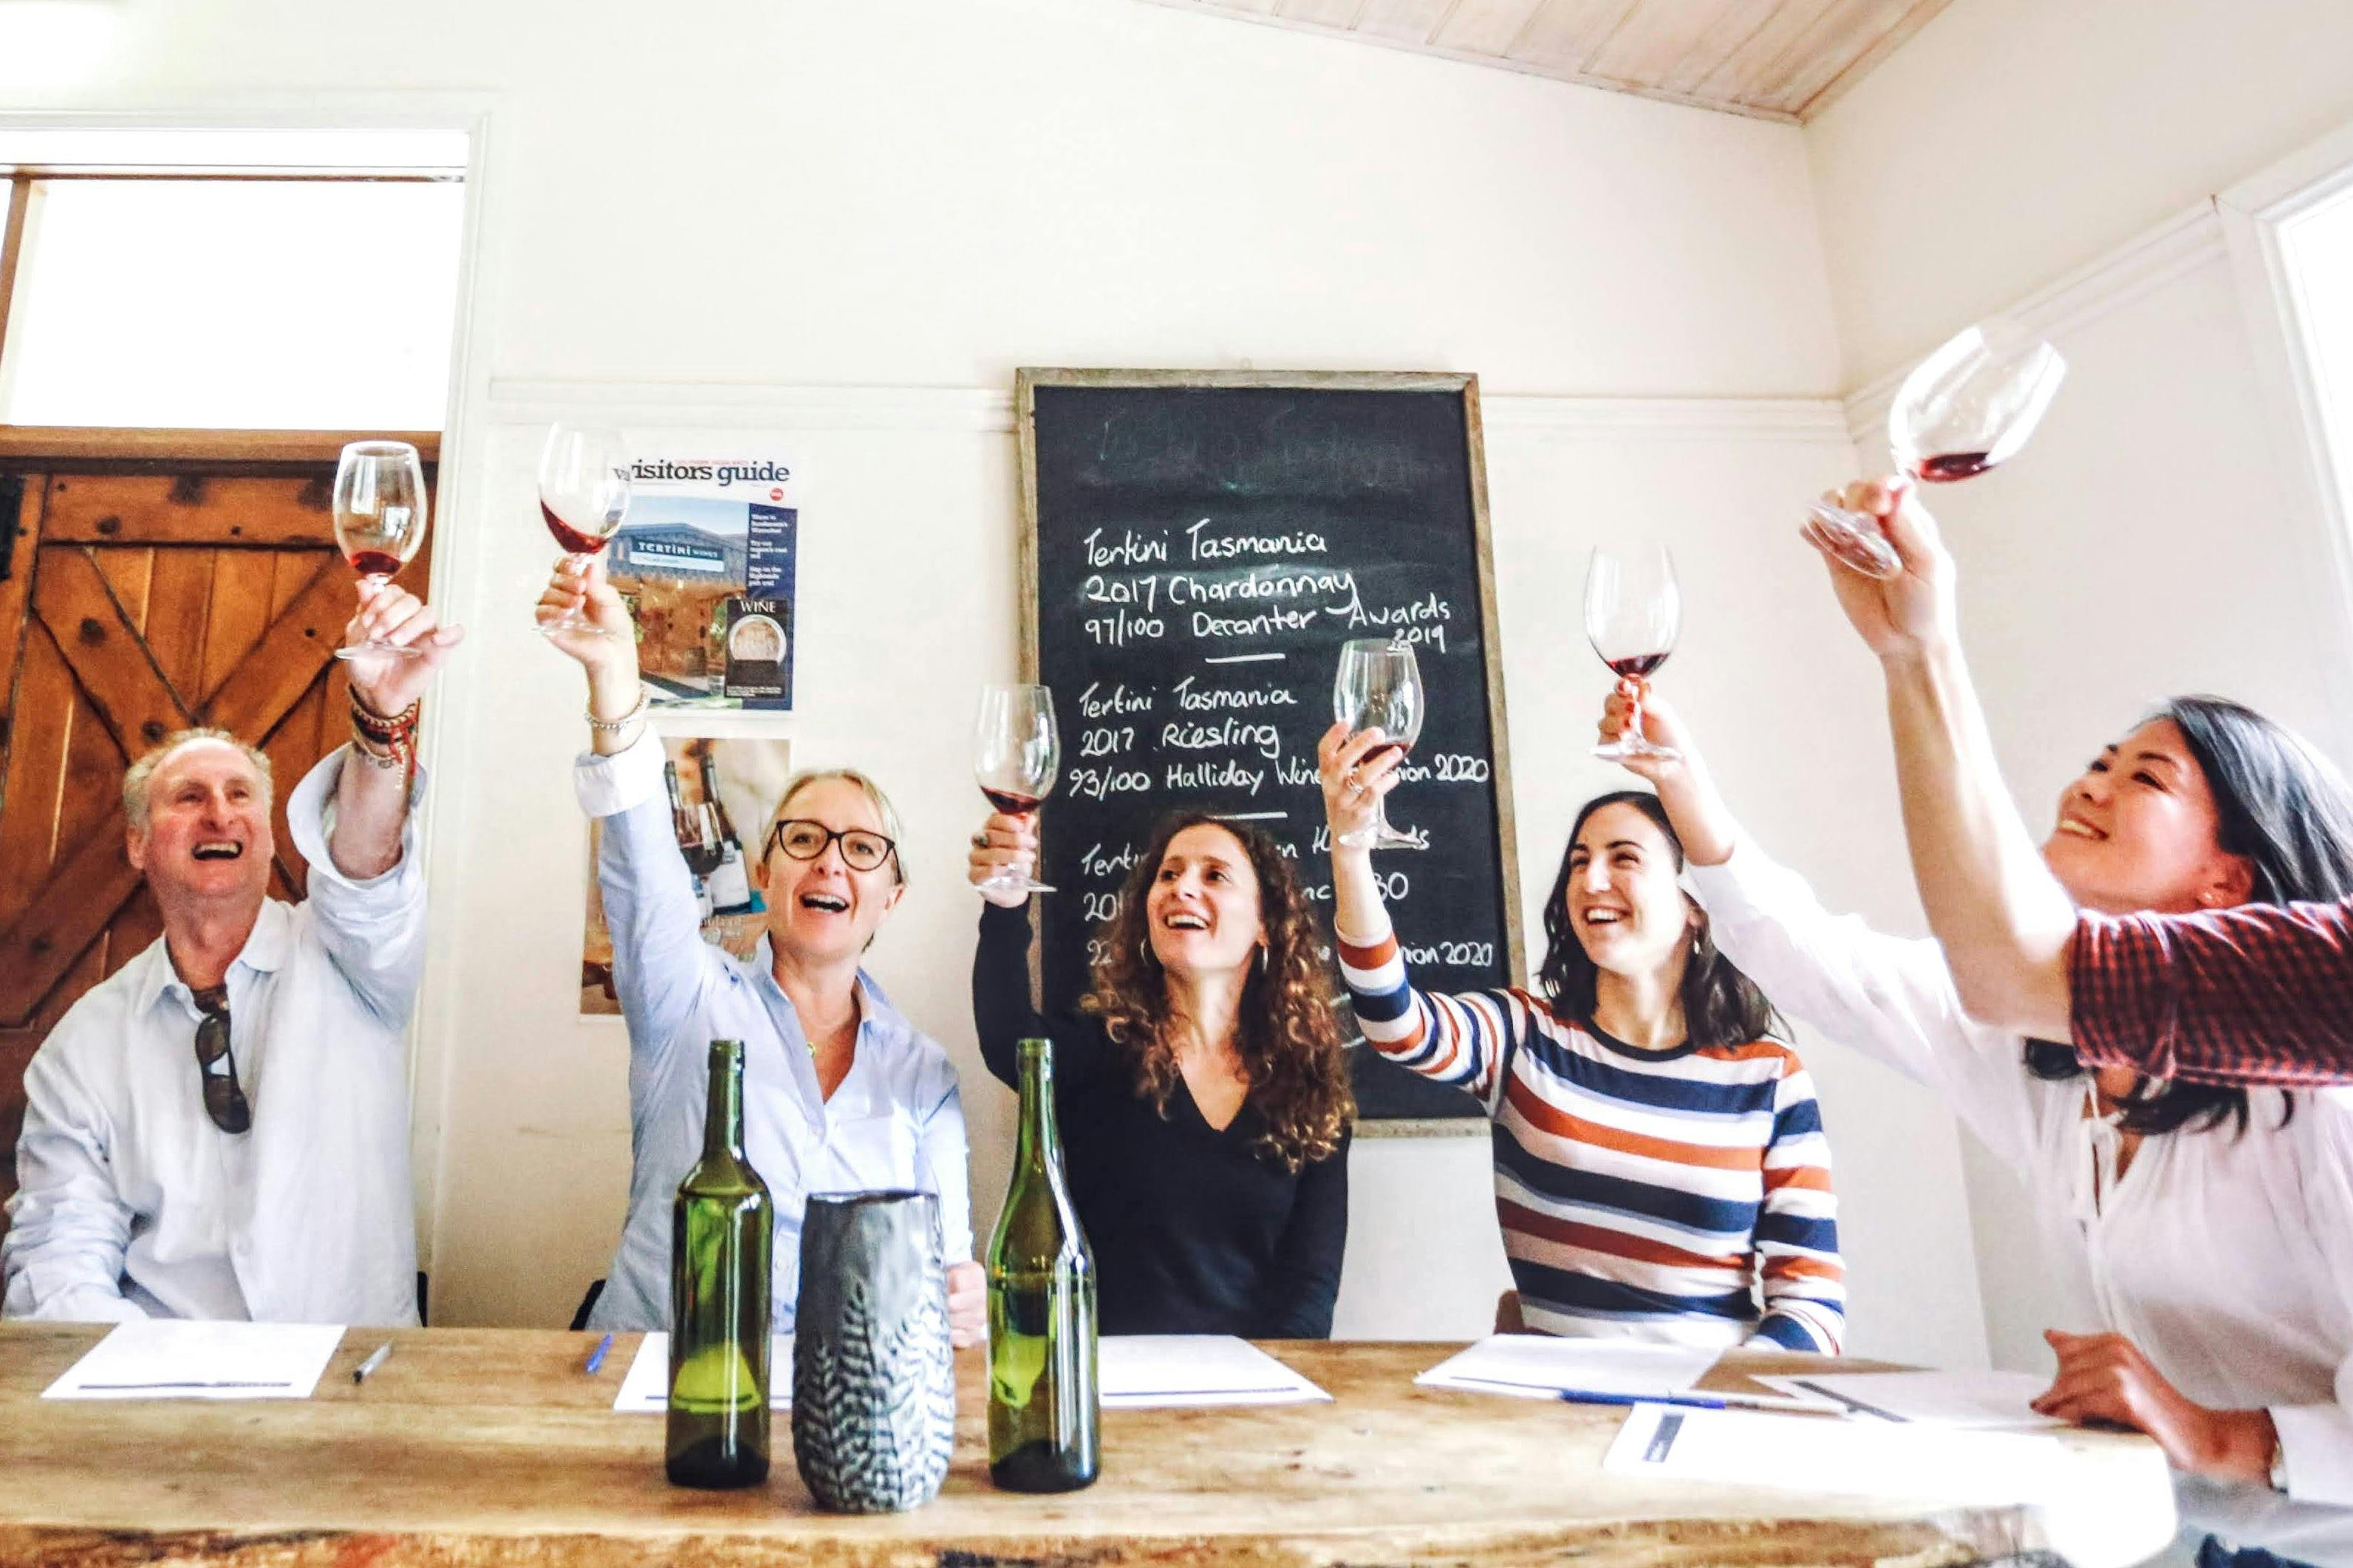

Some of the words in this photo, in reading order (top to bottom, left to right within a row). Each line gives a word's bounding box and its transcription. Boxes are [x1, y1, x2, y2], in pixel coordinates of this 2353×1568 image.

[717, 461, 790, 487] guide
[1083, 527, 1167, 567] Tertini
[1185, 518, 1327, 561] Tasmania
[740, 600, 776, 614] WINE
[1085, 575, 1157, 613] 2017
[1168, 572, 1357, 615] Chardonnay
[1085, 608, 1164, 647] 97/100
[1192, 604, 1317, 637] Decanter
[1348, 592, 1450, 629] Awards
[1386, 624, 1446, 654] 2019
[1079, 681, 1156, 718] Tertini
[1172, 676, 1298, 711] Tasmania
[1079, 727, 1135, 757] 2017
[1161, 716, 1280, 759] Riesling
[1068, 766, 1151, 801] 93/100
[1166, 759, 1264, 796] Halliday
[1434, 753, 1489, 783] 2020
